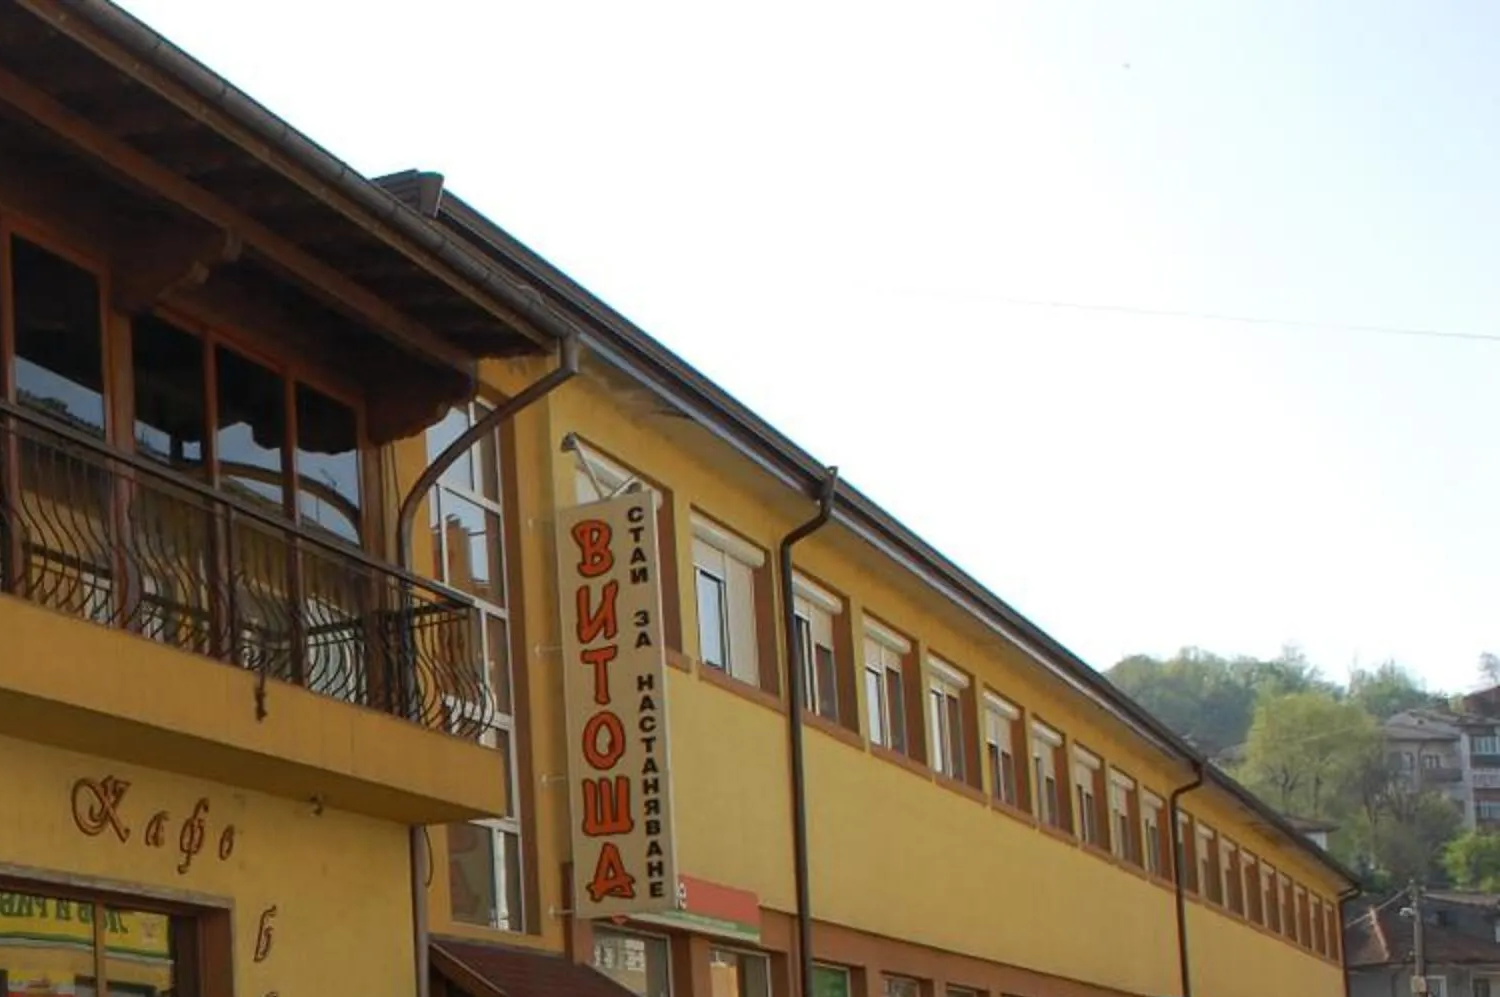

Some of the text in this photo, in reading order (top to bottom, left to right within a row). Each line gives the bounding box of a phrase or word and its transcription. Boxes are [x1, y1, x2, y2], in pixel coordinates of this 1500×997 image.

[570, 518, 636, 903] ВИТОША
[626, 505, 666, 899] СТАИ ЗА НАСТАНЯВАНЕ
